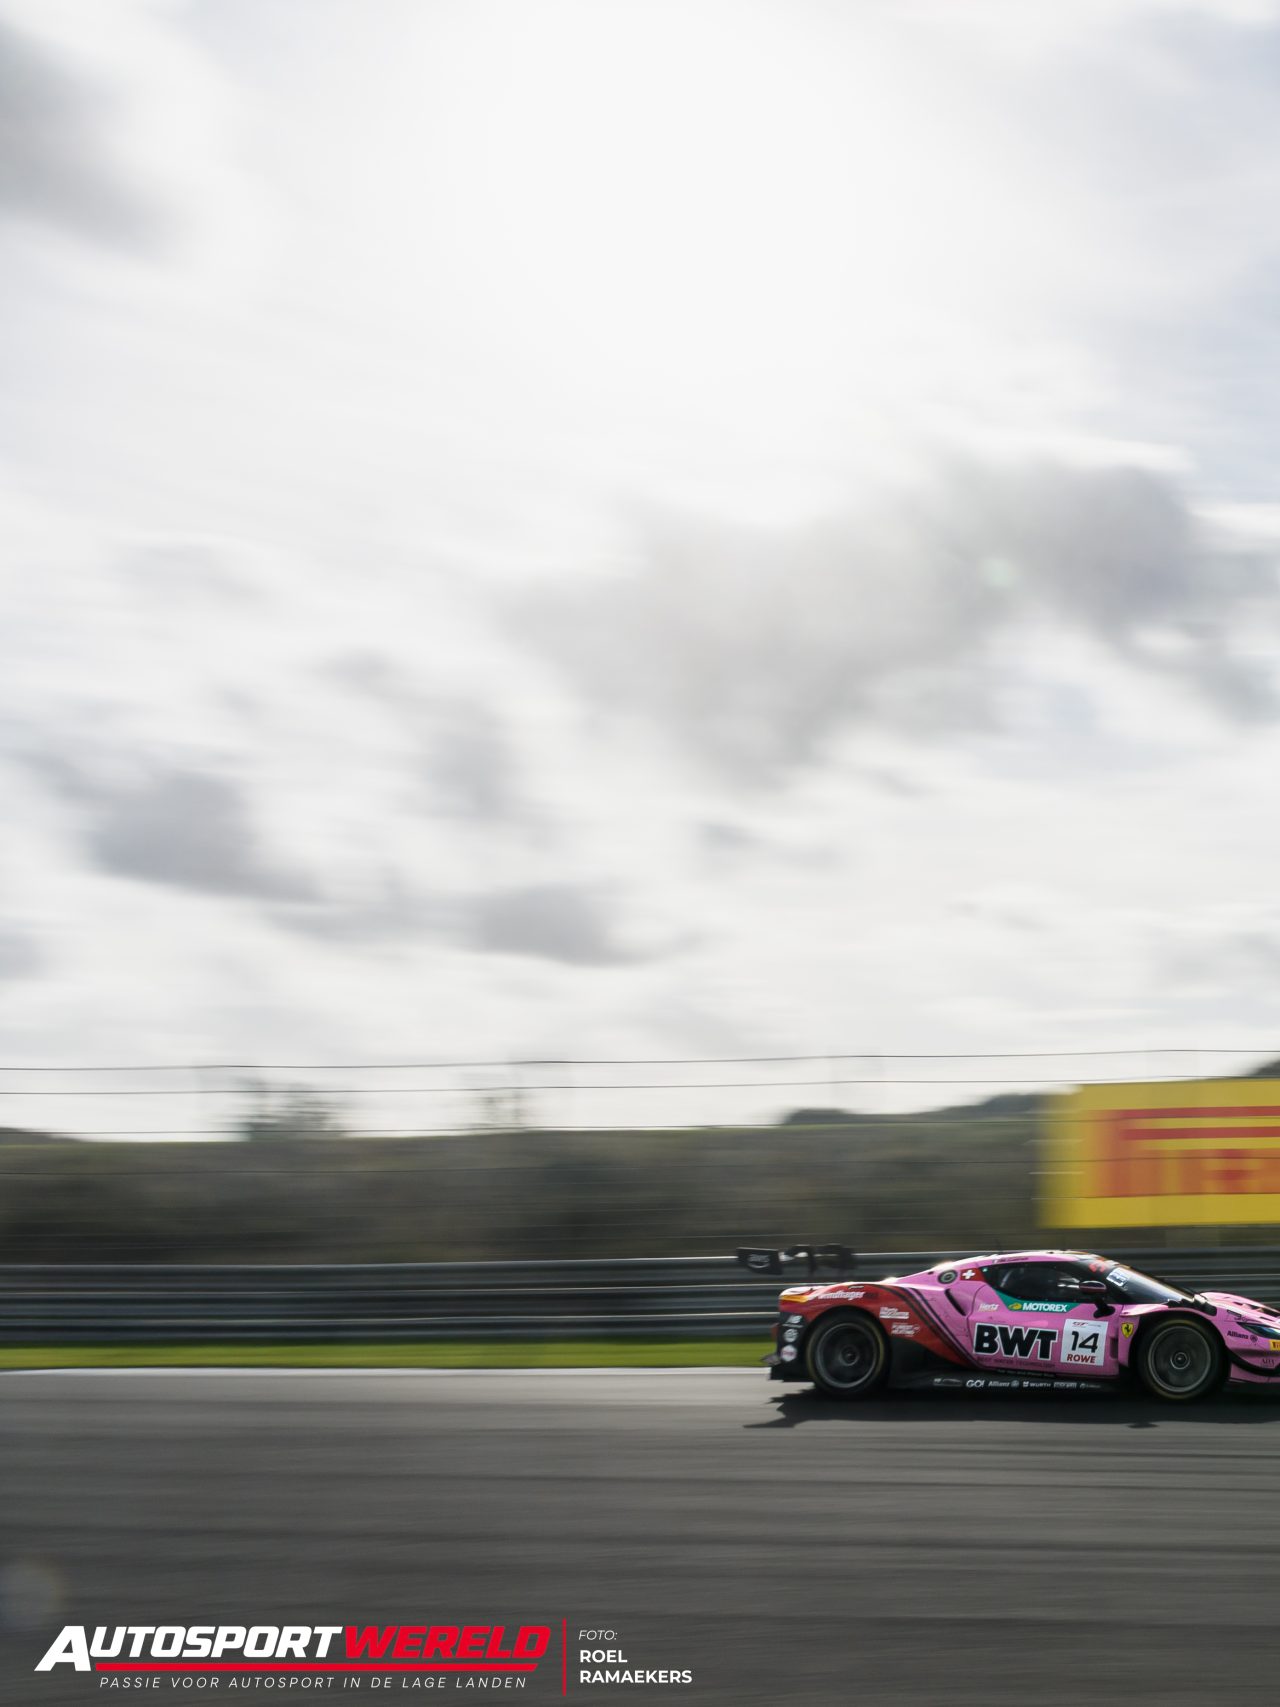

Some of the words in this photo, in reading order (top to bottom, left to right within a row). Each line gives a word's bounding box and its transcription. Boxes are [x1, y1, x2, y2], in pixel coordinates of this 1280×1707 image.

[1022, 1302, 1068, 1313] MOTOREX
[1227, 1330, 1248, 1339] Allianz
[974, 1323, 1058, 1360] BWT
[1071, 1330, 1100, 1354] 14
[1066, 1353, 1096, 1364] ROWE
[966, 1380, 985, 1388] GO!
